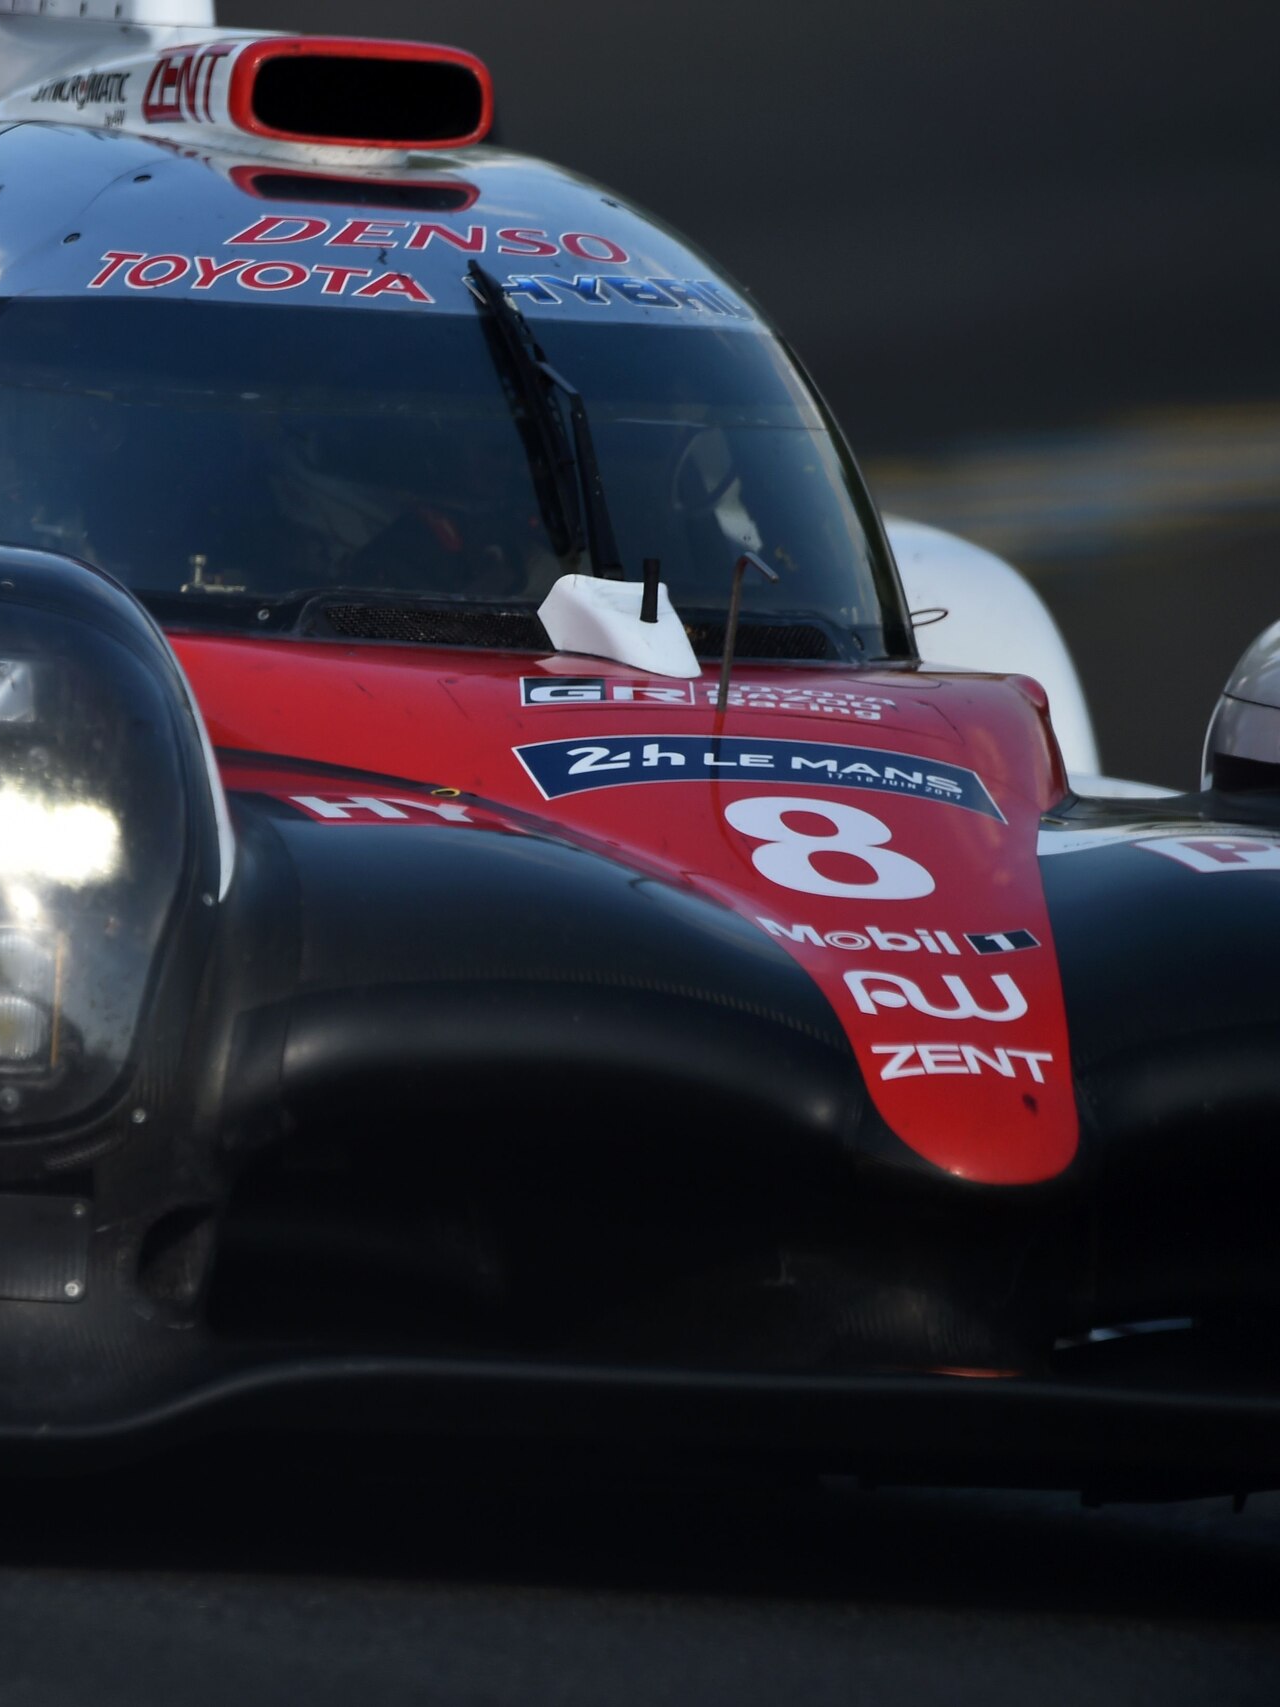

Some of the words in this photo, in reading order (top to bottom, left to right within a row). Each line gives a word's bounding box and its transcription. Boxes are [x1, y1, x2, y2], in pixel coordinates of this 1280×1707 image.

[223, 215, 630, 264] DENSO
[86, 251, 436, 303] TOYOTA
[528, 684, 687, 703] GR
[703, 682, 898, 708] TOYOTA
[566, 743, 686, 775] 24h
[703, 752, 775, 768] LE
[791, 756, 963, 794] MANS
[288, 796, 474, 823] HY
[724, 796, 935, 900] 8
[1177, 840, 1280, 864] P
[756, 916, 962, 956] Mobil
[871, 1043, 1054, 1084] ZENT
